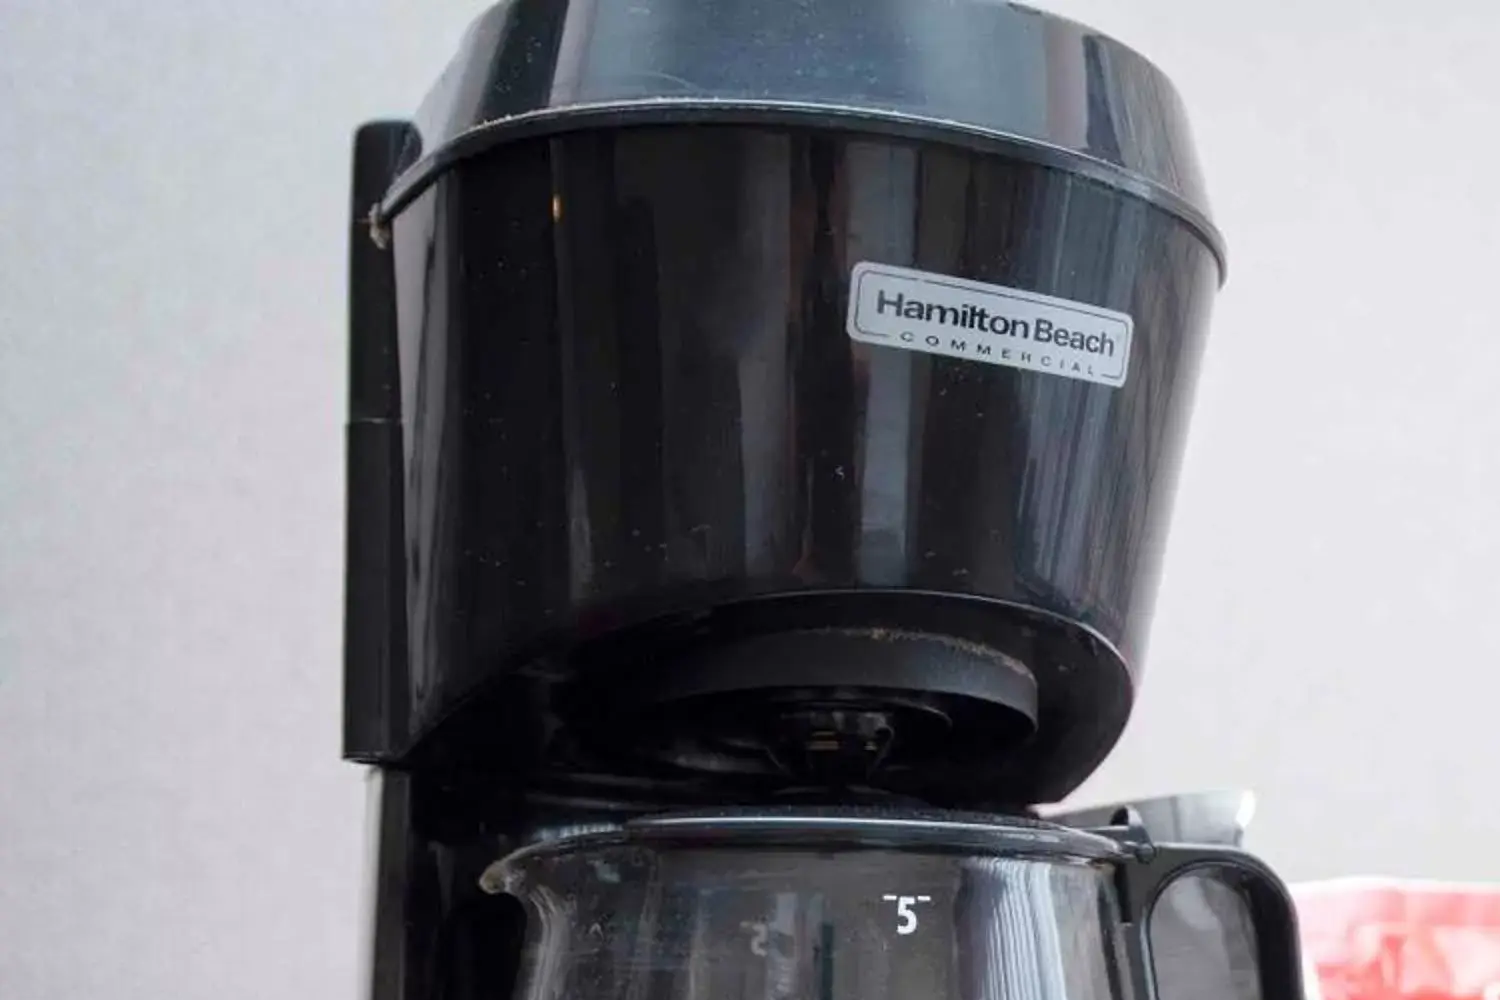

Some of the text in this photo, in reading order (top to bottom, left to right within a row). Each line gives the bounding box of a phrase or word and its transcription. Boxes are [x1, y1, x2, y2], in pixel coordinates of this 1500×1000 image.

[876, 290, 1114, 358] Hamilton Beach
[901, 330, 1095, 376] COMMERCIAL
[896, 898, 917, 934] 5
